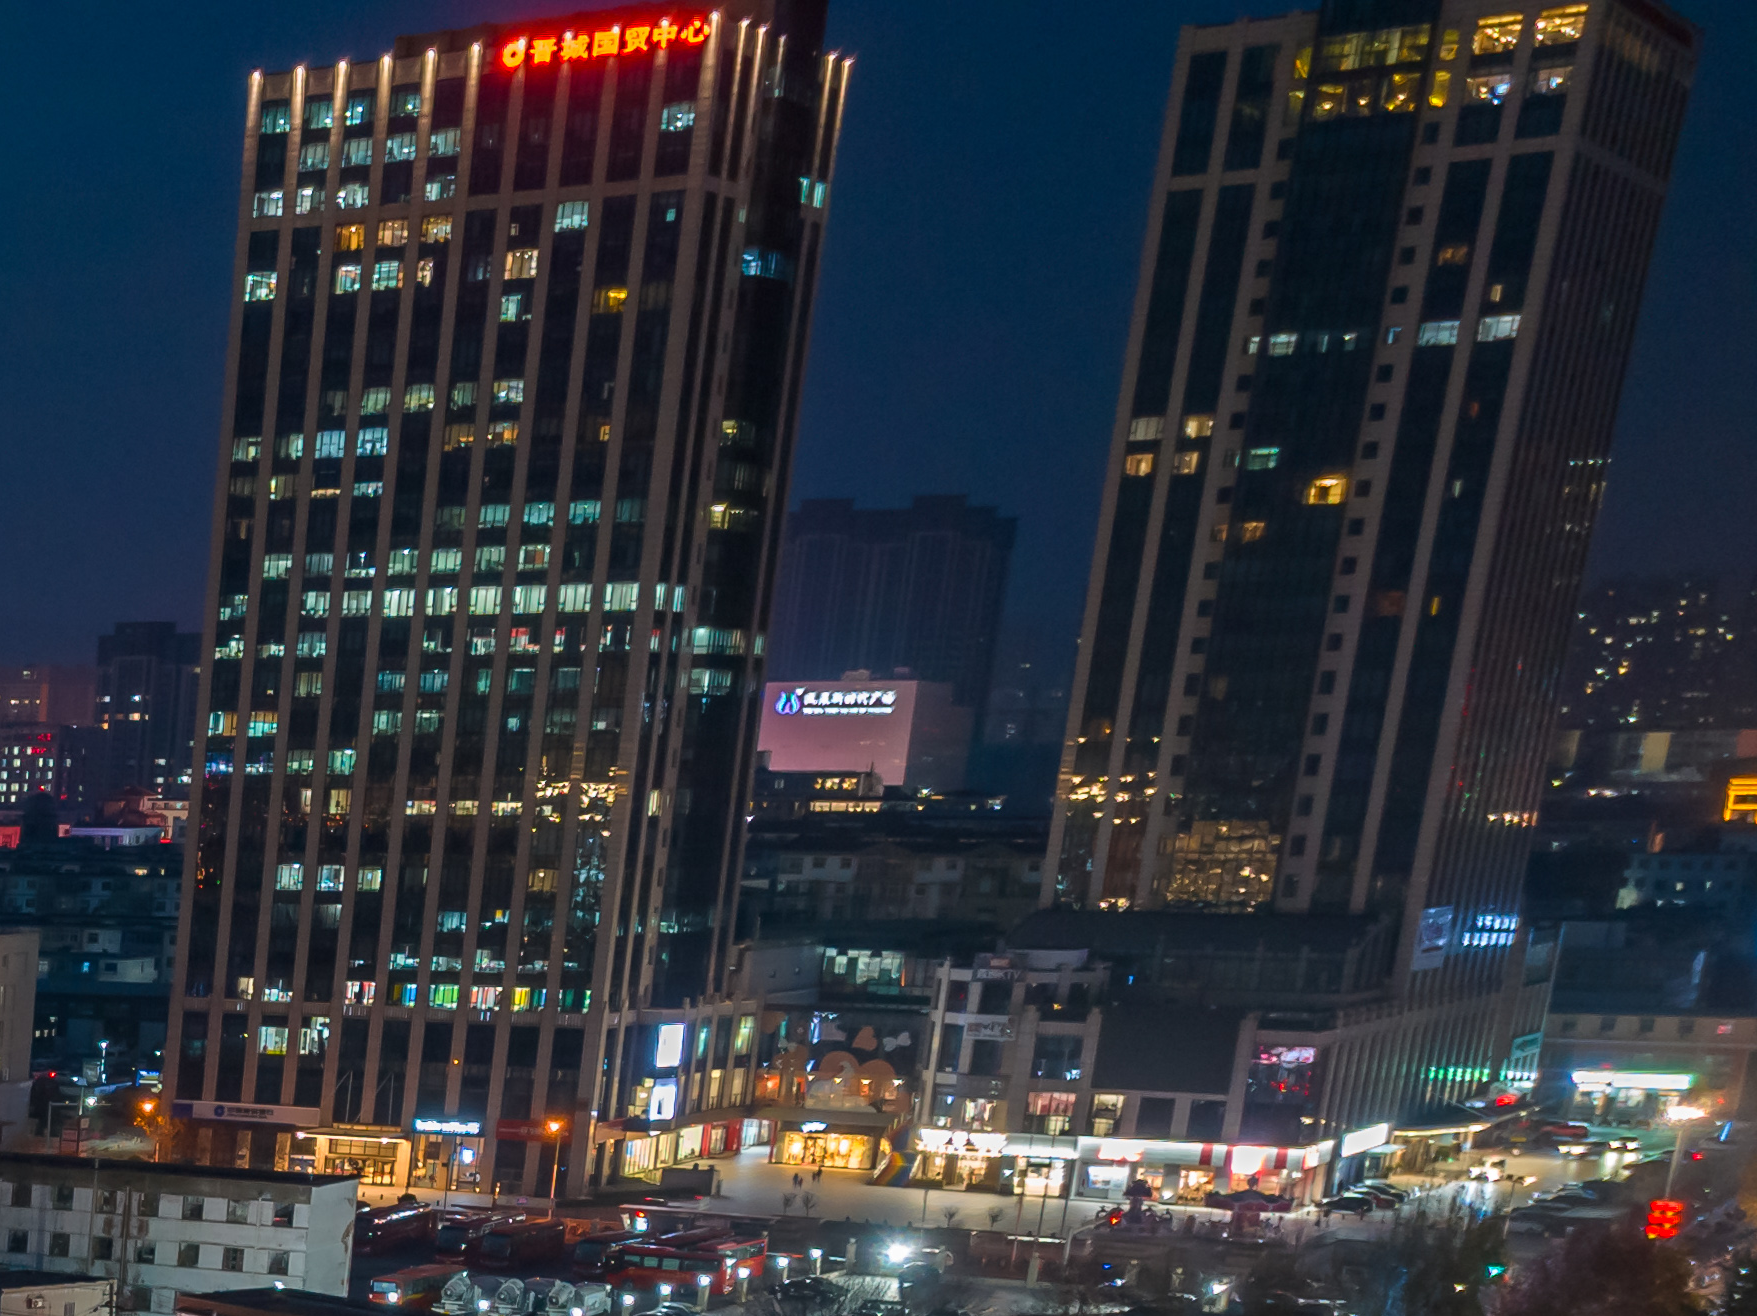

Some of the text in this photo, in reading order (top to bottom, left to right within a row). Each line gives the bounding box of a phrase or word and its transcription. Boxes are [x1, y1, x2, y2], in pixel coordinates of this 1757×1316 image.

[529, 20, 710, 65] 晋城国贸中心
